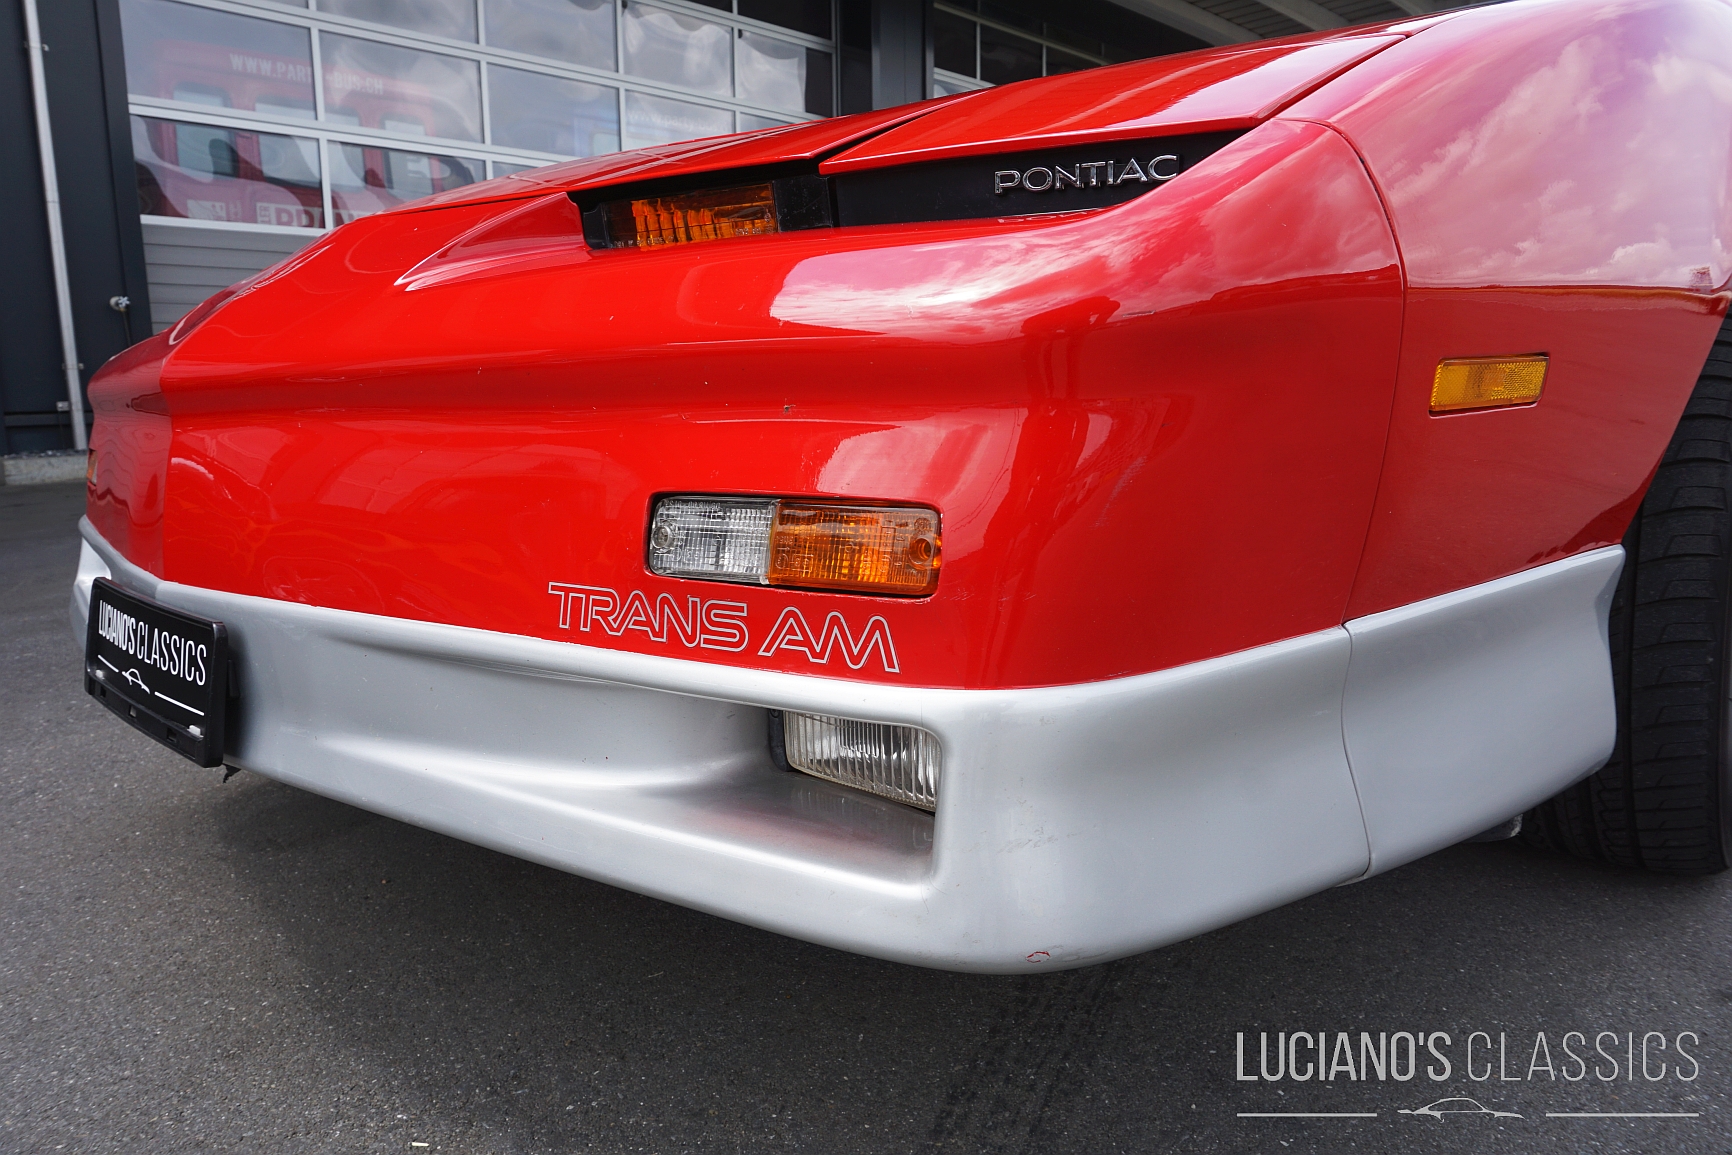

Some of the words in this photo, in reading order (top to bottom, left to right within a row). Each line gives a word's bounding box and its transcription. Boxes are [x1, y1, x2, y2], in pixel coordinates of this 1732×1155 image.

[229, 53, 384, 96] WWW.PART-BUS.CH
[994, 154, 1178, 195] PONTIAC
[98, 600, 136, 655] LUCIANO'S
[136, 620, 207, 686] CLASSICS
[548, 577, 748, 652] TRANS
[757, 606, 901, 673] AM
